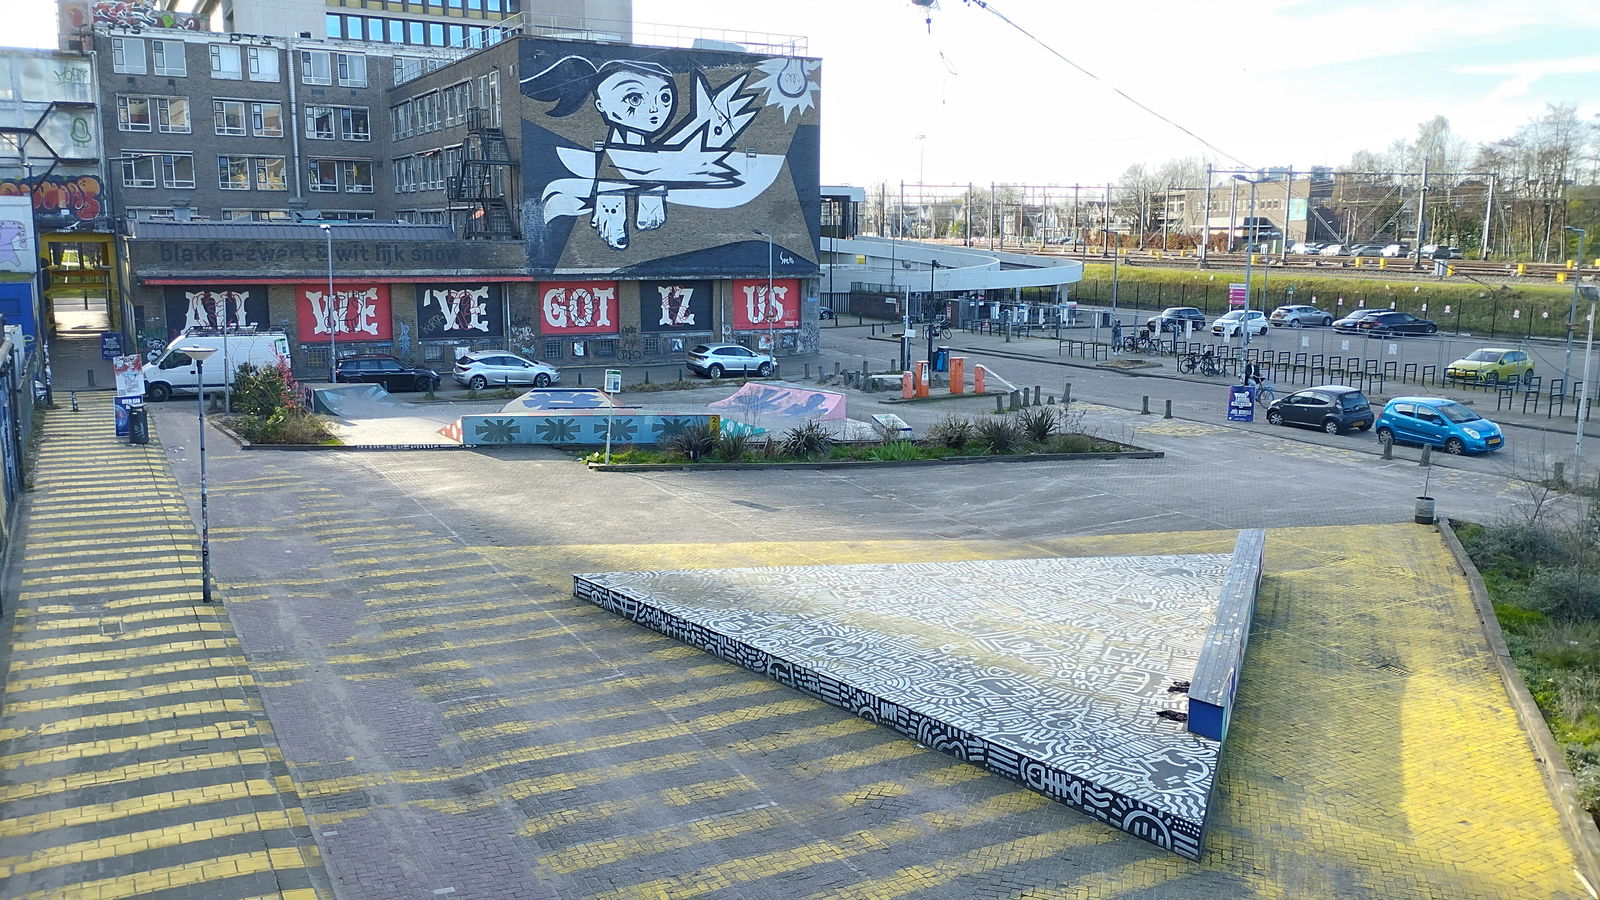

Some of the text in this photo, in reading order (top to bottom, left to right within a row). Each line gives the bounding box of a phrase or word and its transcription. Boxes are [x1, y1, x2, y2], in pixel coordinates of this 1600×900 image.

[335, 245, 369, 262] wit
[375, 243, 406, 266] lijk
[411, 247, 460, 262] snow
[305, 287, 378, 335] WE
[543, 287, 615, 327] GOT
[658, 285, 695, 326] IZ
[743, 285, 788, 324] US
[1063, 761, 1164, 808] CENTRAL
